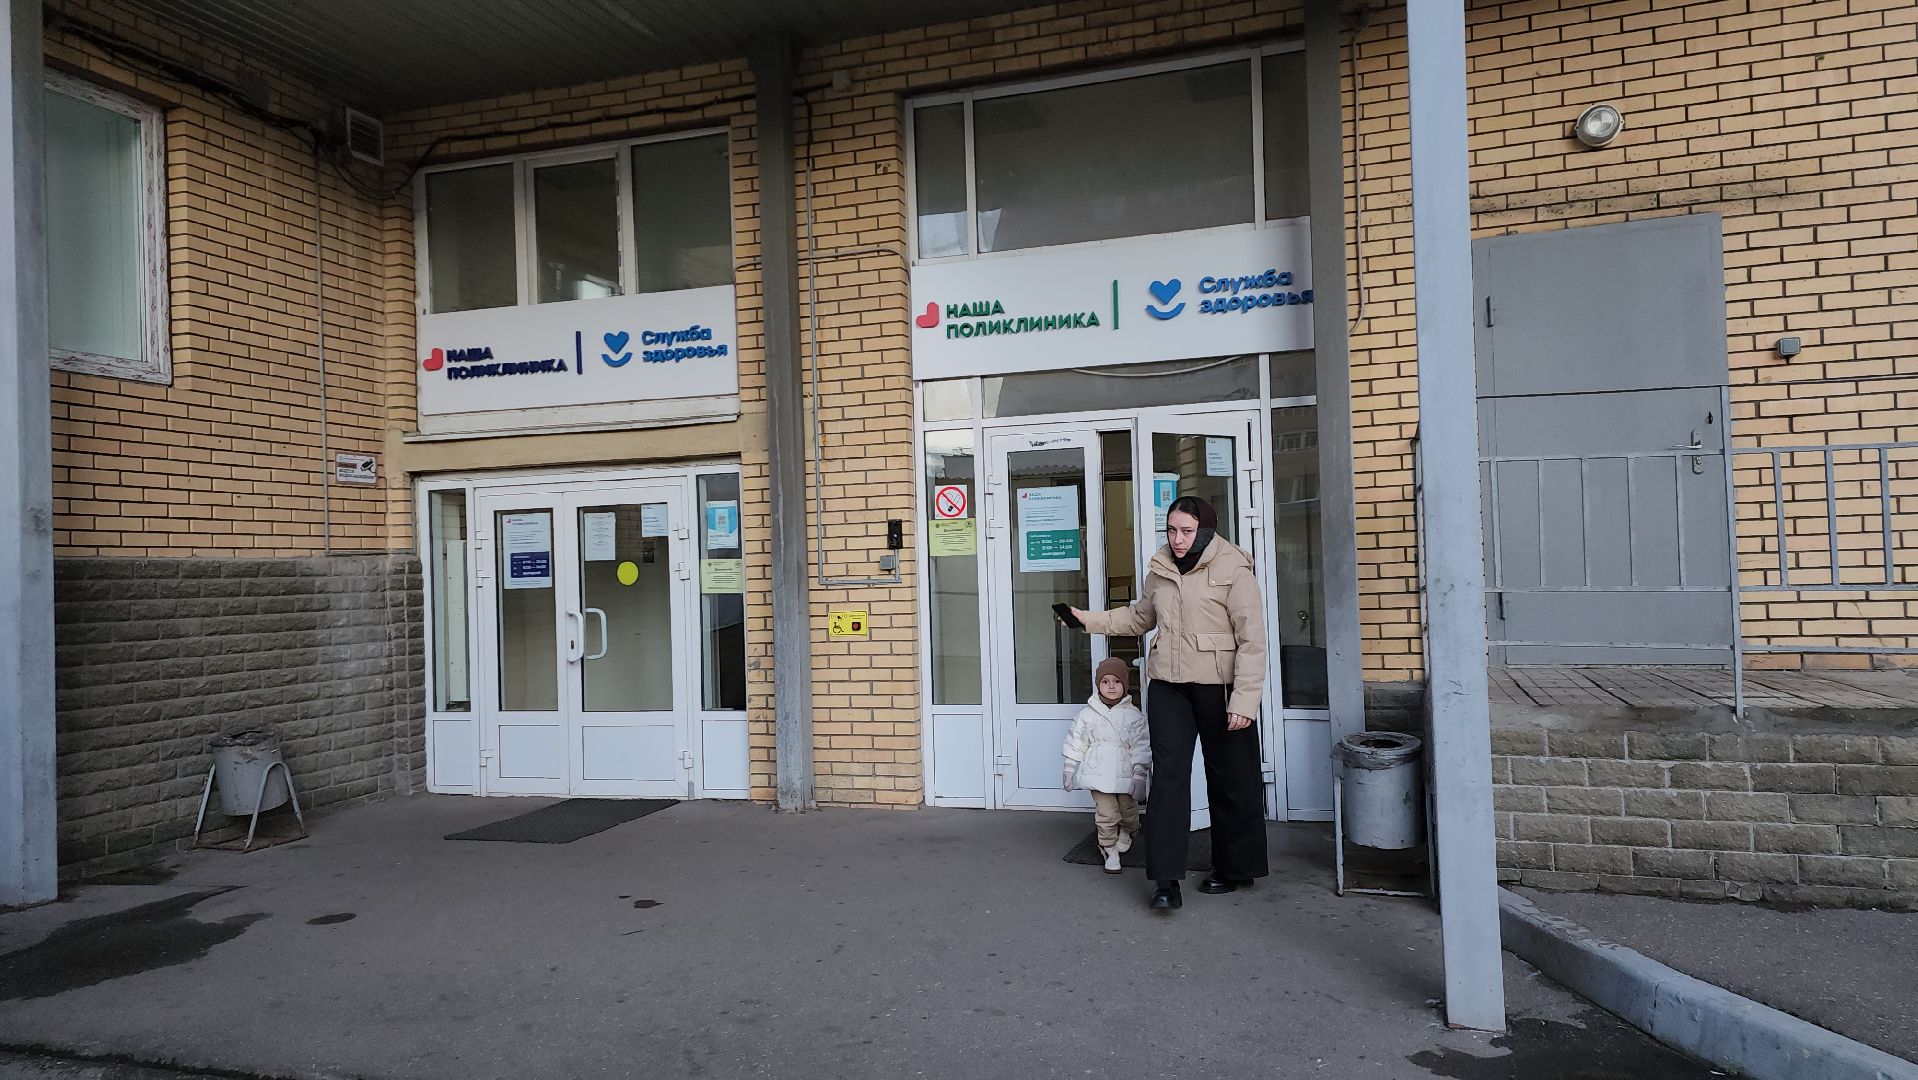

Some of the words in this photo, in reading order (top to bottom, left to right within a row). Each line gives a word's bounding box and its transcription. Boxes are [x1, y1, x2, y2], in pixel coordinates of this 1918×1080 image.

[1199, 268, 1294, 295] Служба
[946, 299, 1005, 319] НАША
[1199, 289, 1313, 314] здоровья
[641, 325, 712, 347] Служба
[946, 311, 1100, 339] ПОЛИКЛИНИКА
[446, 346, 494, 362] НАША
[642, 344, 728, 363] здоровья
[446, 358, 568, 380] ПОЛИКЛИНИКА
